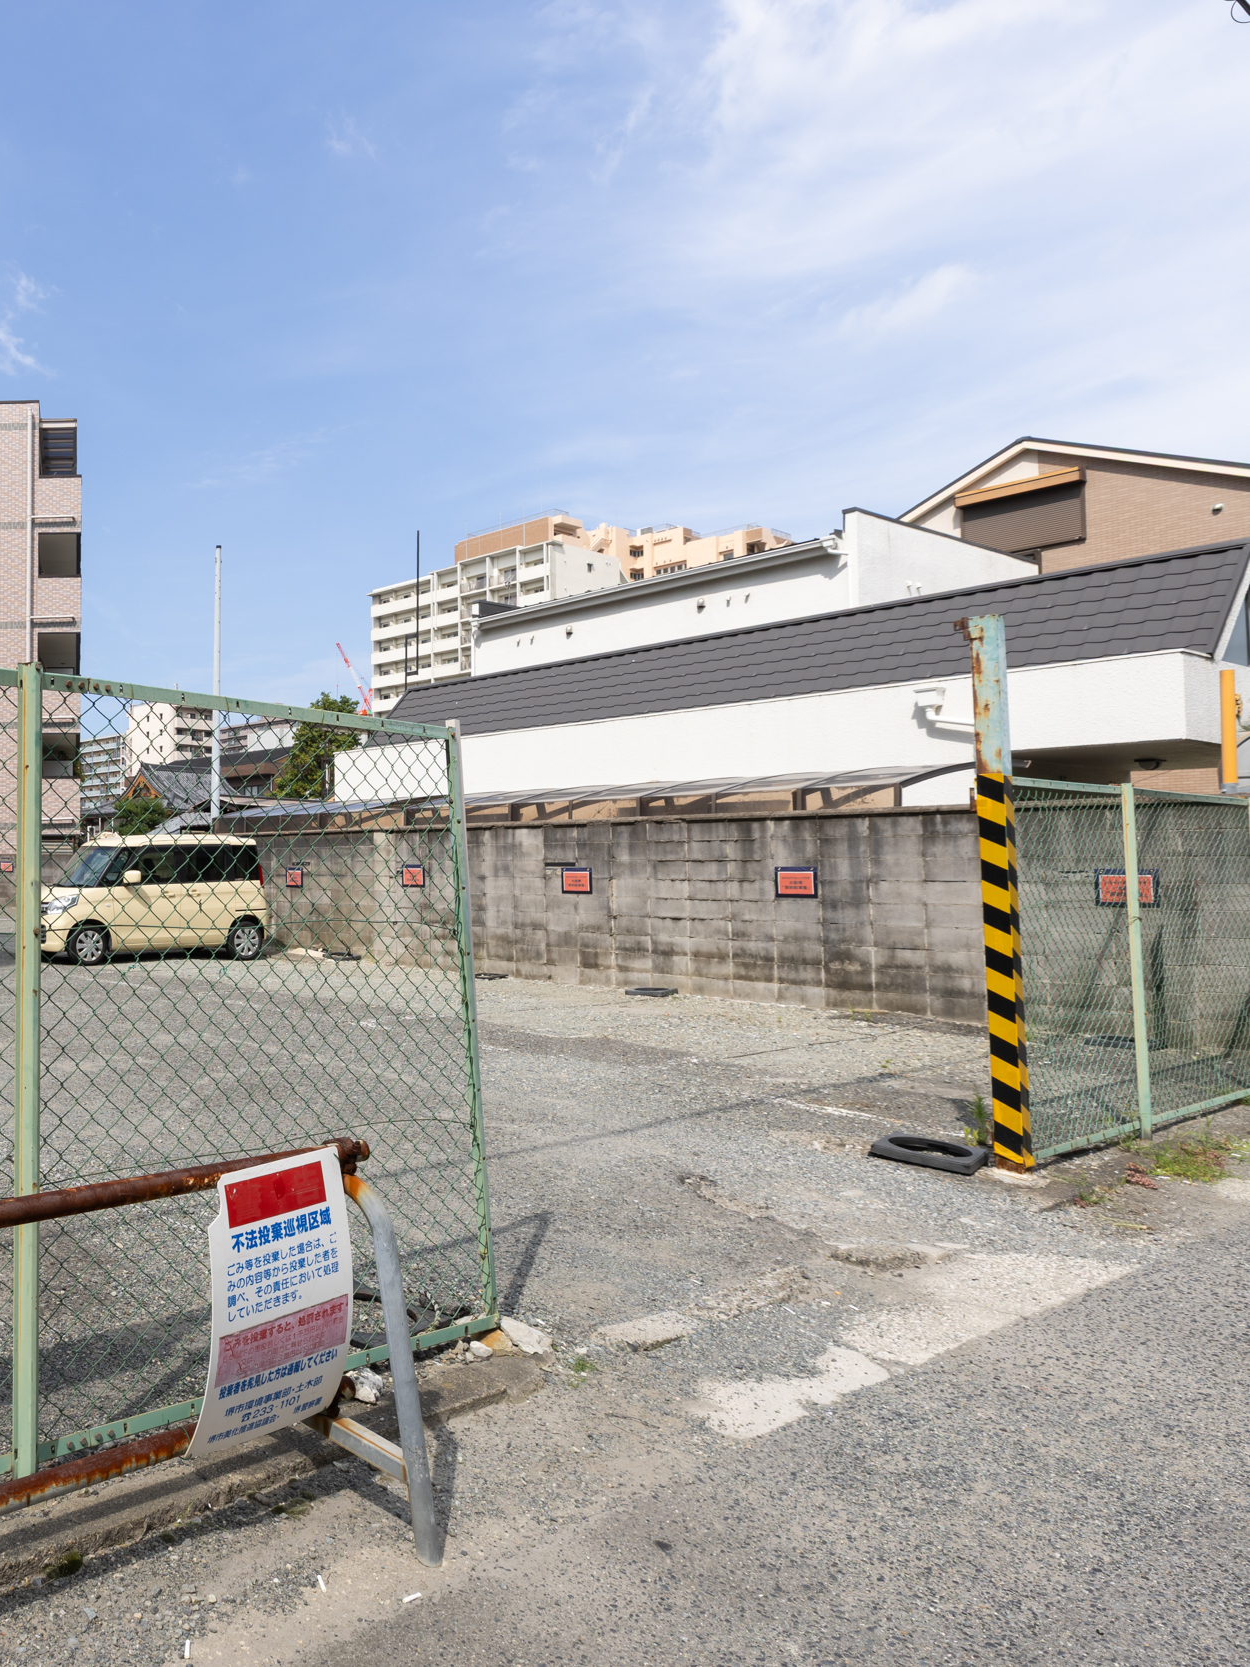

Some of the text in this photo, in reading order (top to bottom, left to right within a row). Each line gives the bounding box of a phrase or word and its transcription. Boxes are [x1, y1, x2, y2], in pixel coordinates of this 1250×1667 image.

[231, 1206, 332, 1254] 不法投棄巡視区域
[227, 1231, 337, 1277] ごみ等を投棄した場合は、ご
[227, 1247, 338, 1292] みの内容等から投棄した者を
[227, 1261, 339, 1308] 調べ、その責任において処理
[228, 1289, 303, 1322] していただきます。
